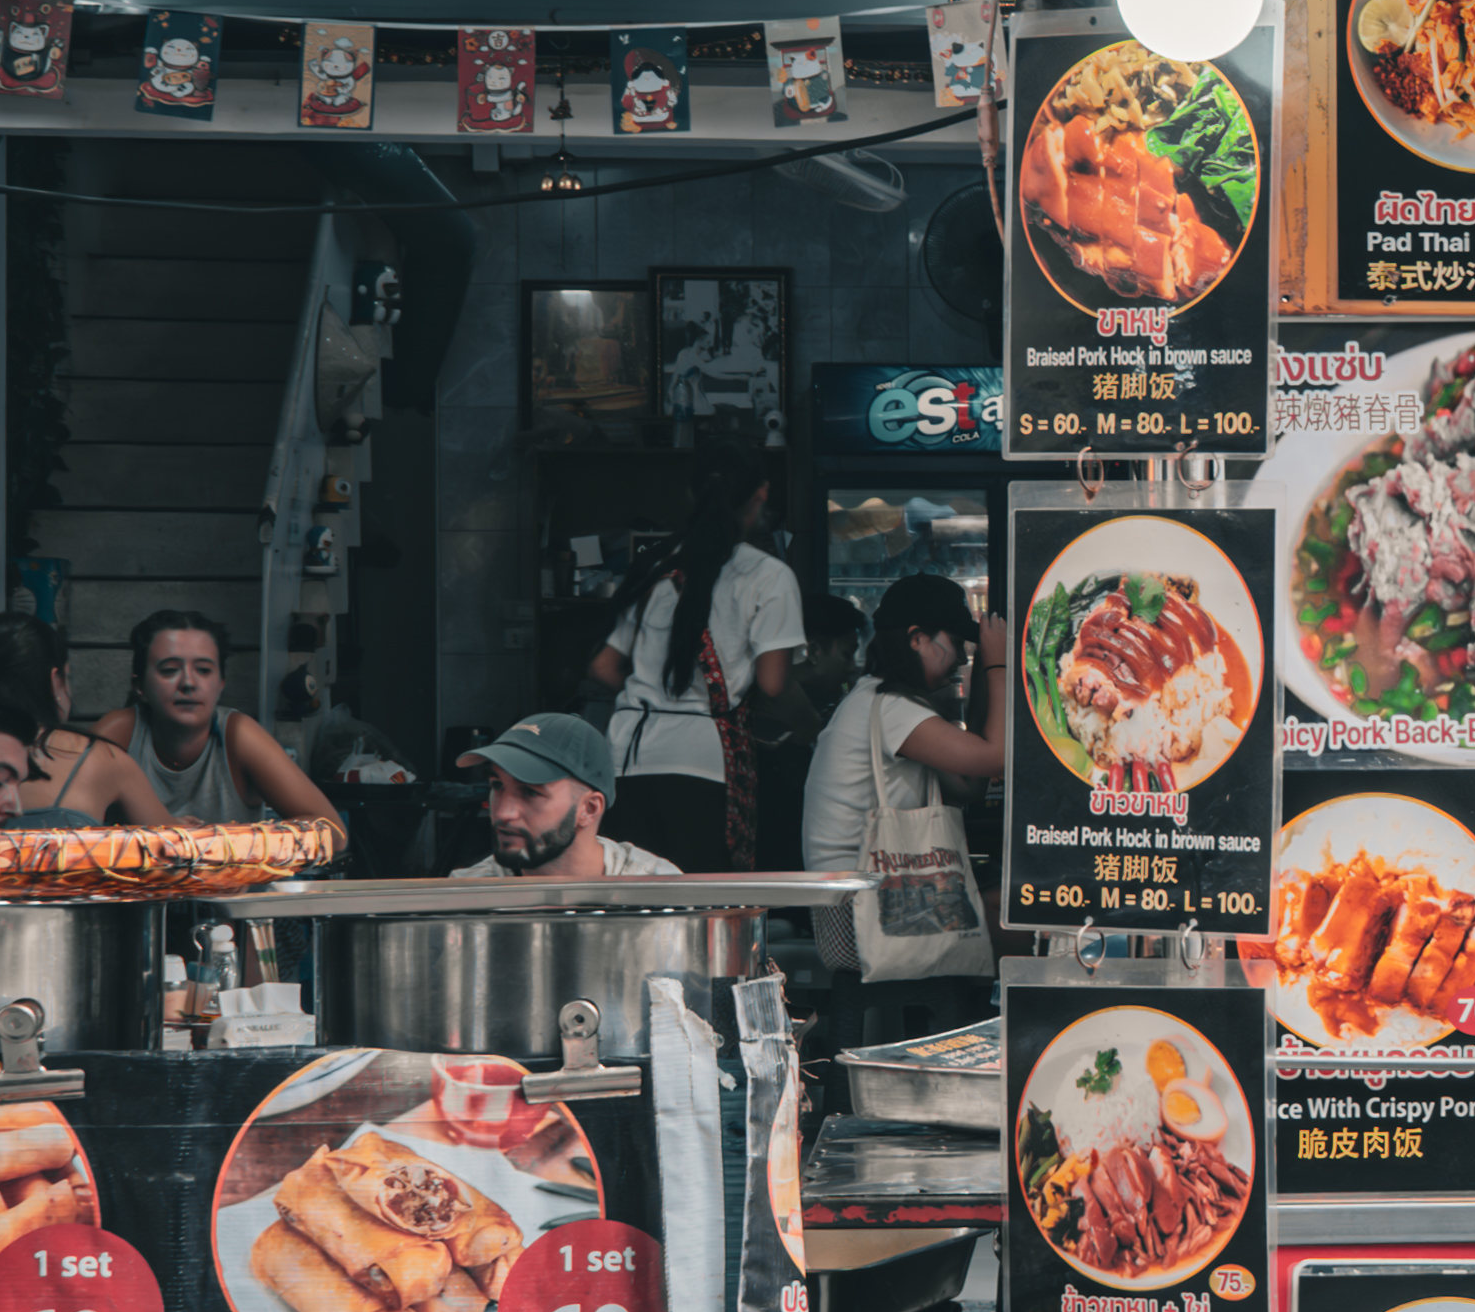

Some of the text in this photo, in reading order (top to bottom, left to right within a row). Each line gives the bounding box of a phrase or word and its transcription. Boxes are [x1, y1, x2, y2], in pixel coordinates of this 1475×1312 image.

[490, 32, 507, 49] 吉
[1367, 232, 1411, 251] Pad
[1419, 232, 1469, 252] Thai
[1027, 345, 1252, 367] Braised Pork Hock in brown sauce
[1093, 372, 1176, 400] 猪脚饭
[868, 381, 975, 444] est
[952, 431, 981, 444] COLA
[1329, 717, 1390, 751] Pork
[34, 1248, 113, 1279] 1 set
